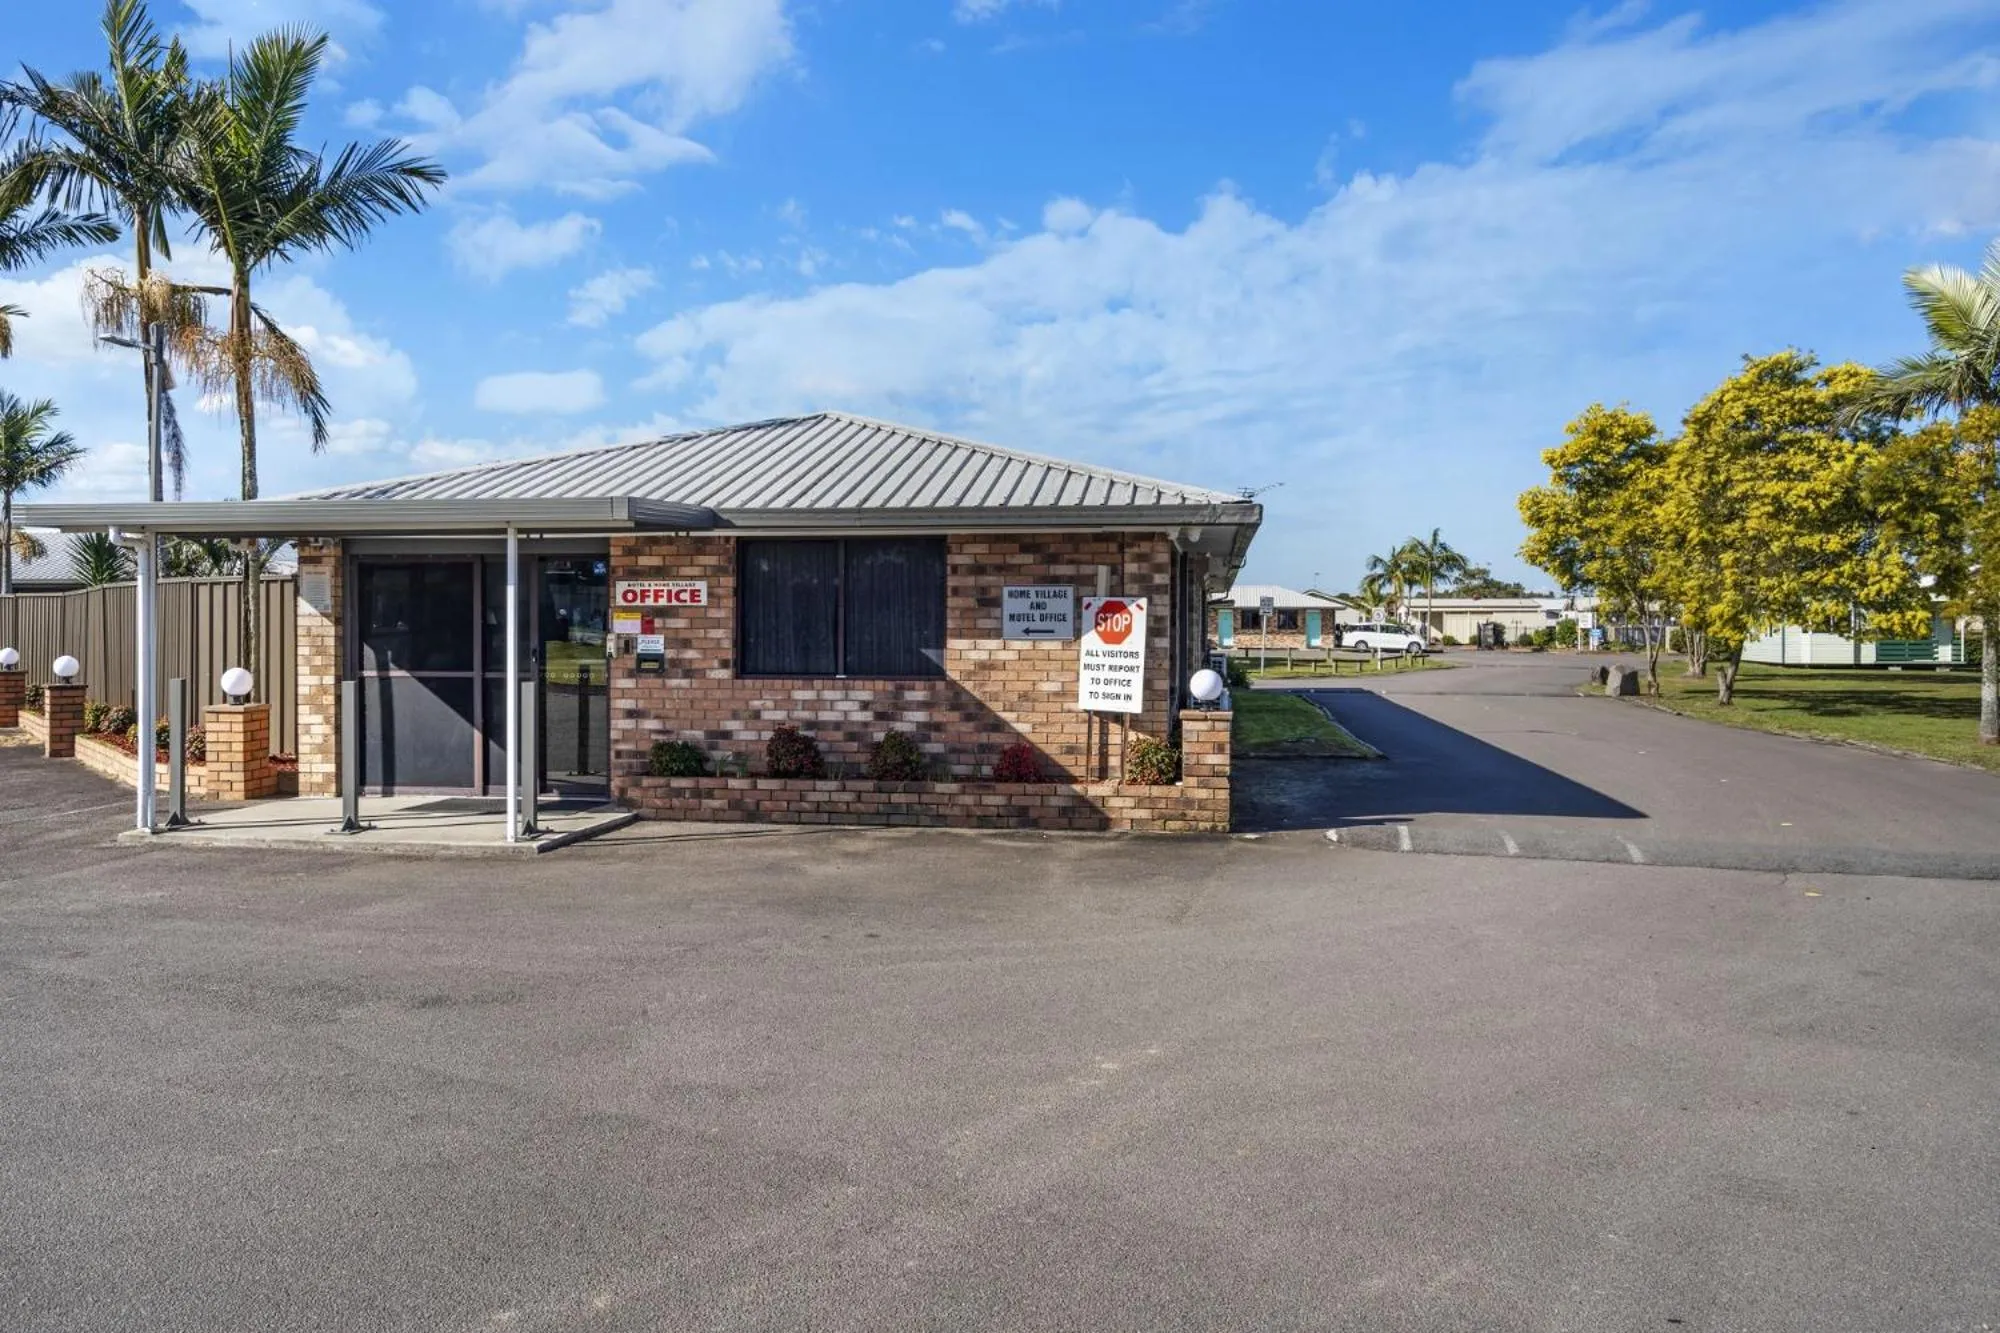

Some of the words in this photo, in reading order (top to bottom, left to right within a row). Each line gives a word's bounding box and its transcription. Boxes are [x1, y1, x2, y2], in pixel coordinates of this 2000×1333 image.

[622, 589, 702, 604] OFFICE
[1008, 589, 1031, 599] HOME
[1035, 589, 1068, 599] VILLAGE
[1030, 601, 1047, 610] AND
[1008, 613, 1036, 622] MOTEL
[1040, 613, 1067, 622] OFFICE
[1096, 613, 1131, 632] STOP
[1085, 649, 1100, 657] ALL
[1102, 650, 1140, 659] VISITORS
[1083, 663, 1106, 671] MUST
[1108, 664, 1140, 673] REPORT
[1090, 677, 1101, 686] TO
[1103, 678, 1132, 687] OFFICE
[1089, 691, 1100, 700] TO
[1101, 692, 1121, 701] SIGN
[1123, 693, 1132, 701] IN
